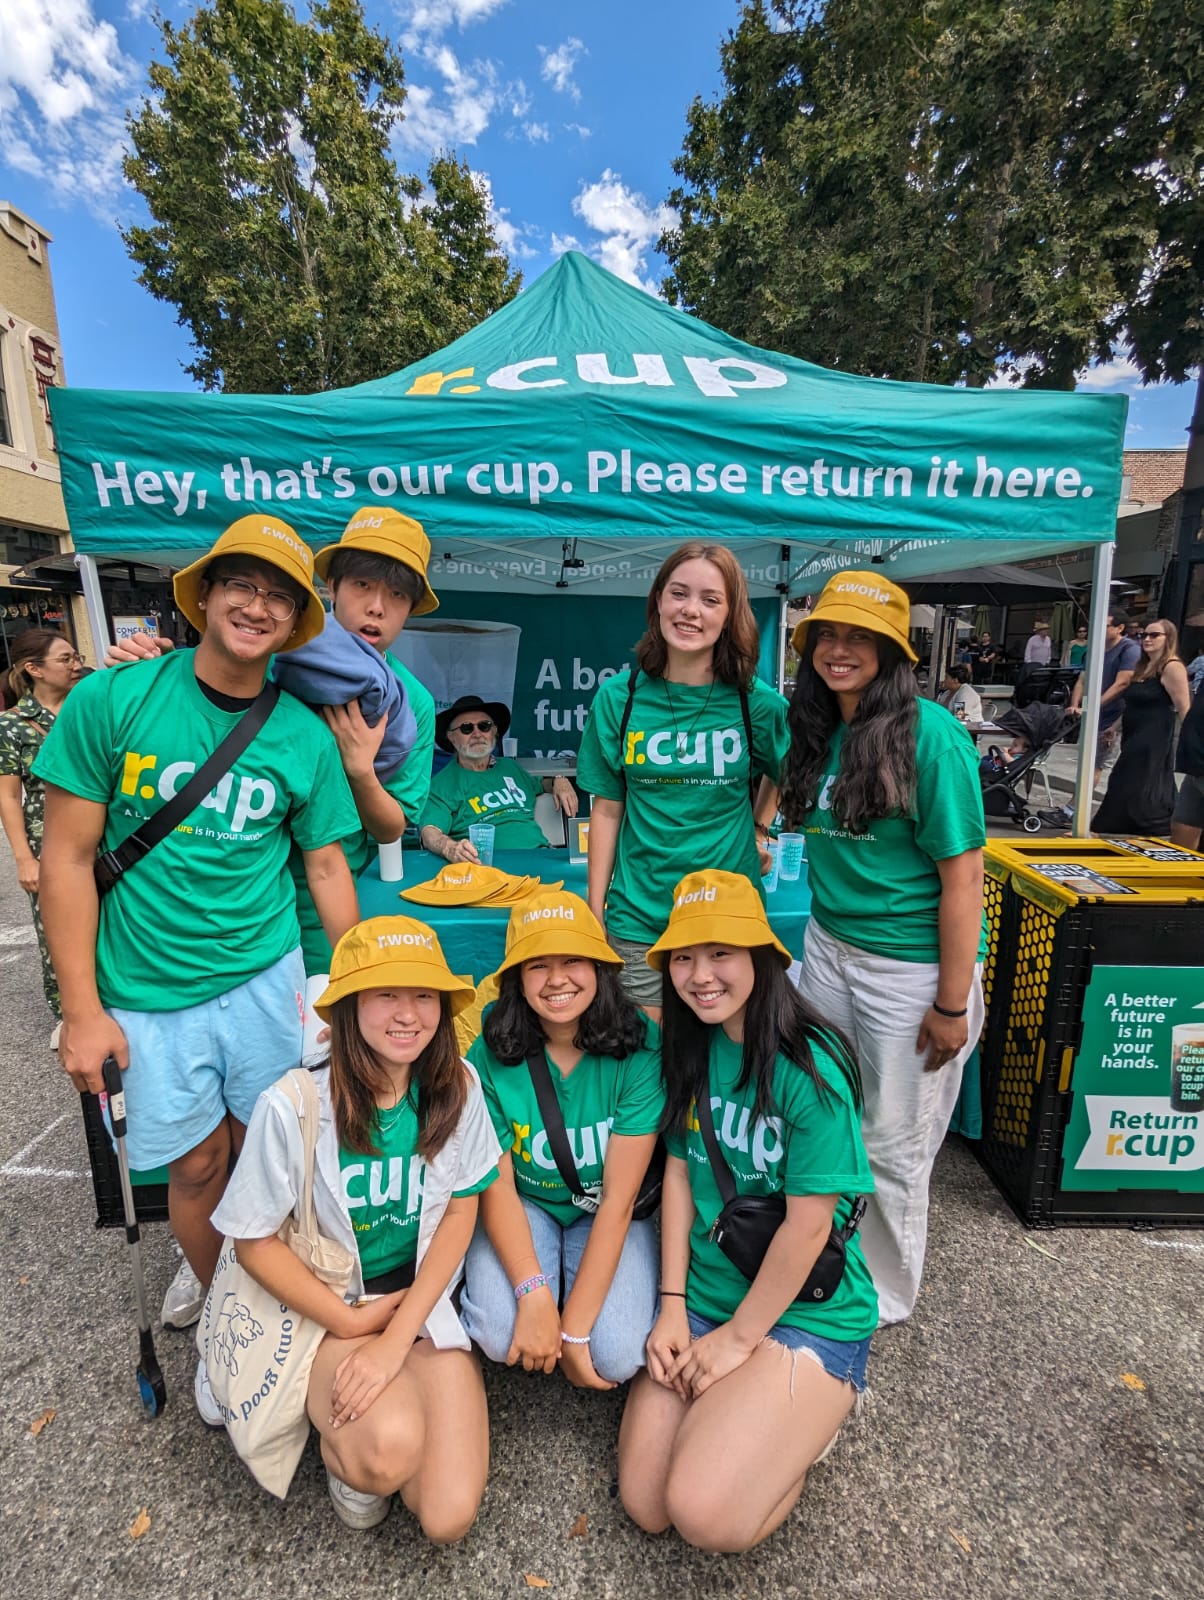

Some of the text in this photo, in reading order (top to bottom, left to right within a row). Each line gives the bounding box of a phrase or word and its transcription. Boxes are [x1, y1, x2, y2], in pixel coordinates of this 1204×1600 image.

[406, 354, 788, 397] r.cup
[92, 449, 1094, 516] Hey, that's our cup. Please return it here.
[836, 582, 891, 606] r.world
[535, 658, 561, 690] A
[625, 728, 742, 776] r.cup
[195, 825, 203, 835] is
[206, 827, 214, 837] in
[523, 906, 575, 924] r.world
[1104, 993, 1177, 1008] A better
[1111, 1009, 1166, 1023] future
[1118, 1025, 1152, 1038] is in
[1112, 1043, 1154, 1057] your
[1101, 1055, 1159, 1069] hands.
[1181, 1073, 1193, 1081] to
[1181, 1091, 1200, 1100] bin.
[1109, 1110, 1198, 1130] Return
[1105, 1133, 1195, 1165] r.cup
[390, 1213, 410, 1226] your
[273, 1320, 293, 1367] only
[240, 1368, 278, 1421] good
